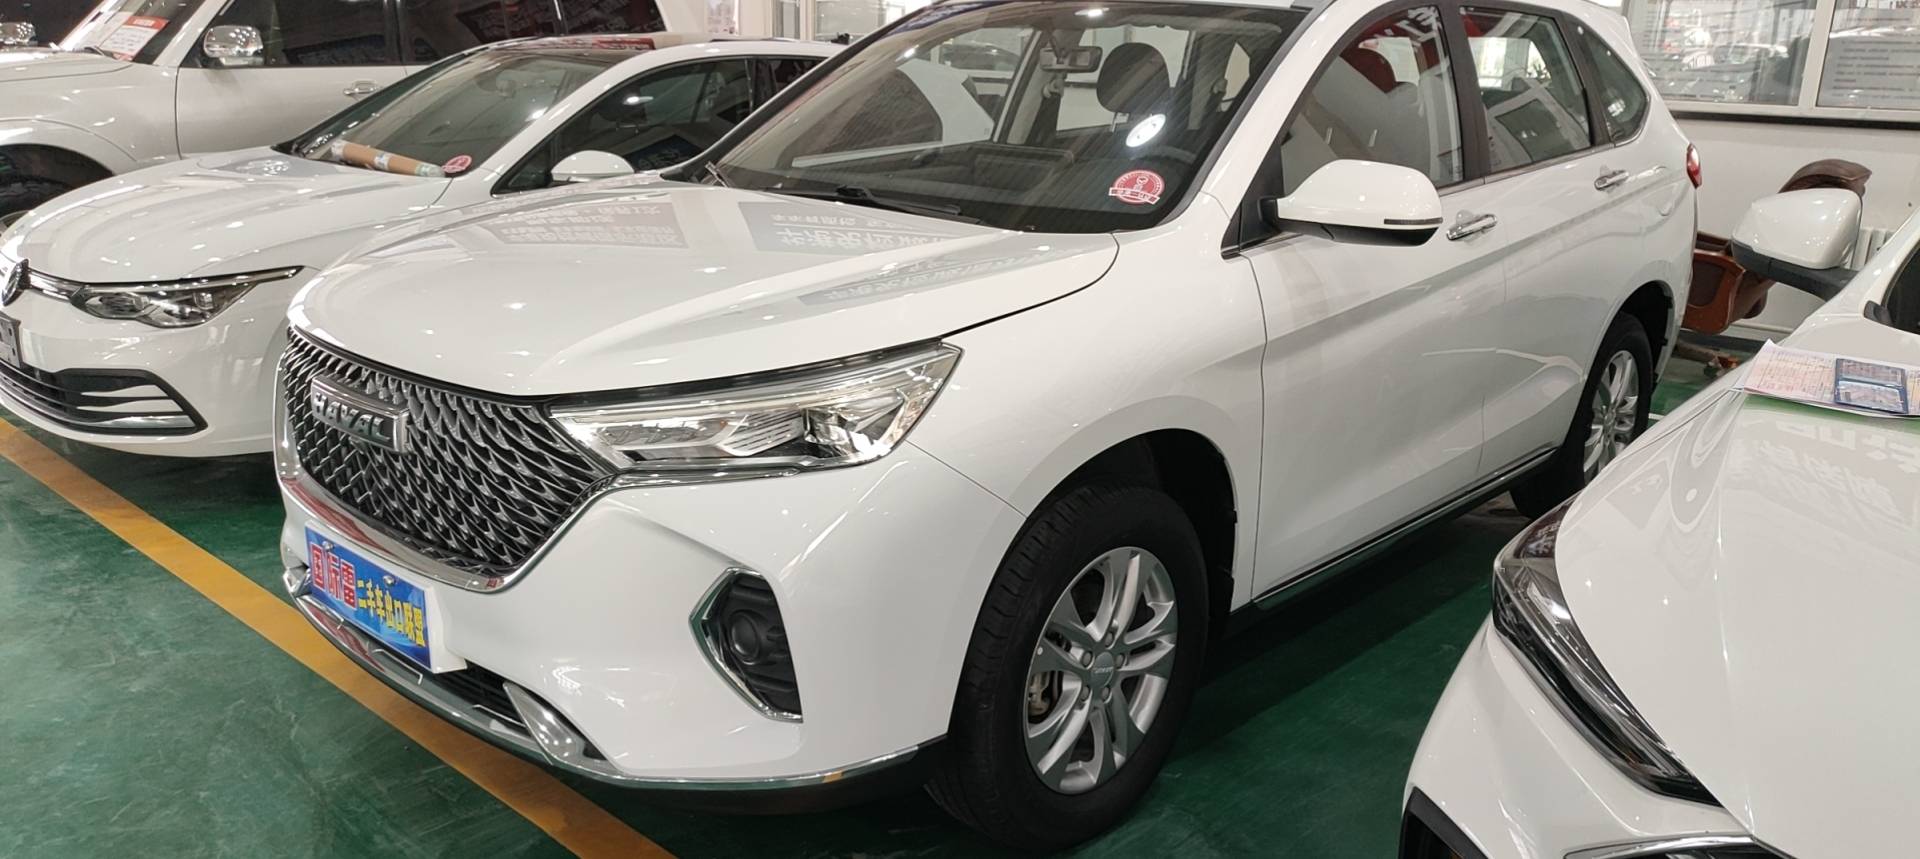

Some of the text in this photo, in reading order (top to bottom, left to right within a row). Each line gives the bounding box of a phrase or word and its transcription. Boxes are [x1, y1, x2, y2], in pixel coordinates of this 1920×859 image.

[311, 391, 392, 443] HAVAL
[356, 577, 426, 648] 二手车出口联盟
